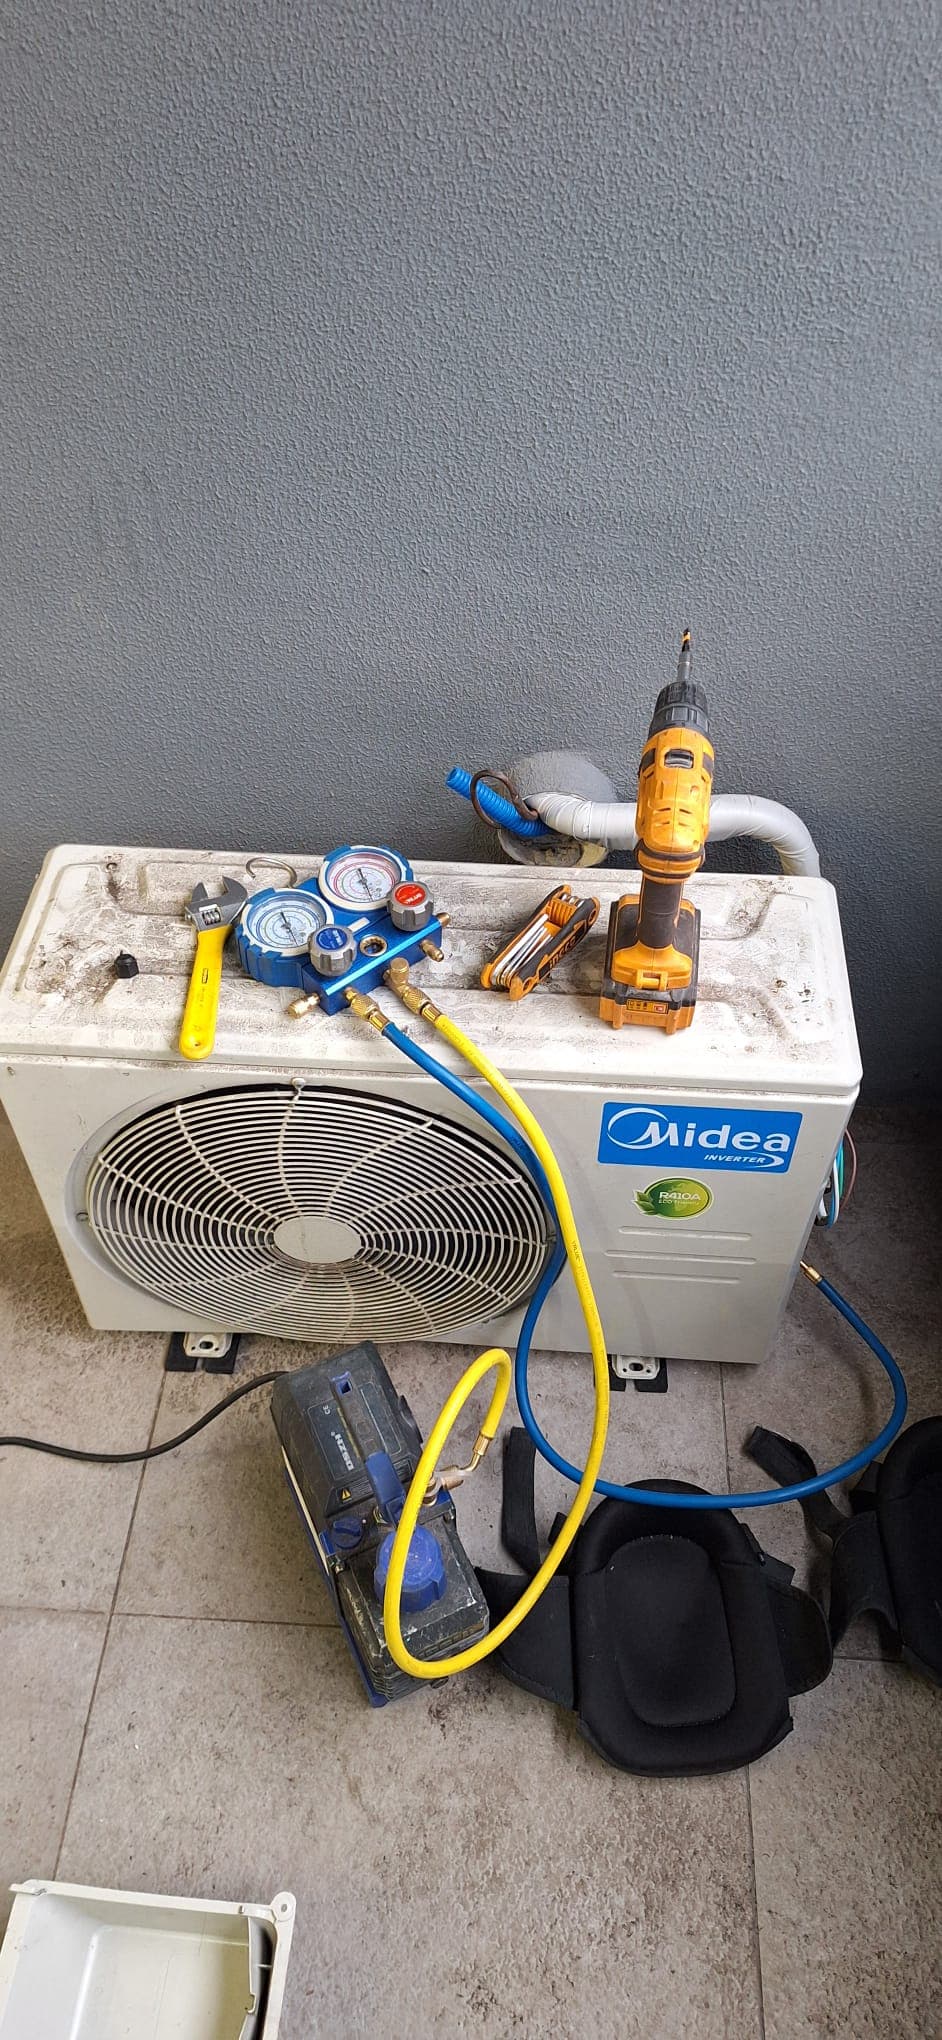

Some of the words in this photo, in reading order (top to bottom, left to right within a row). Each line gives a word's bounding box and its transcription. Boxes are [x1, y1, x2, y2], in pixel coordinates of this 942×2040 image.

[607, 1108, 791, 1153] Midea
[704, 1154, 766, 1164] INVERTER
[659, 1191, 701, 1201] R410A
[322, 1404, 331, 1415] CE
